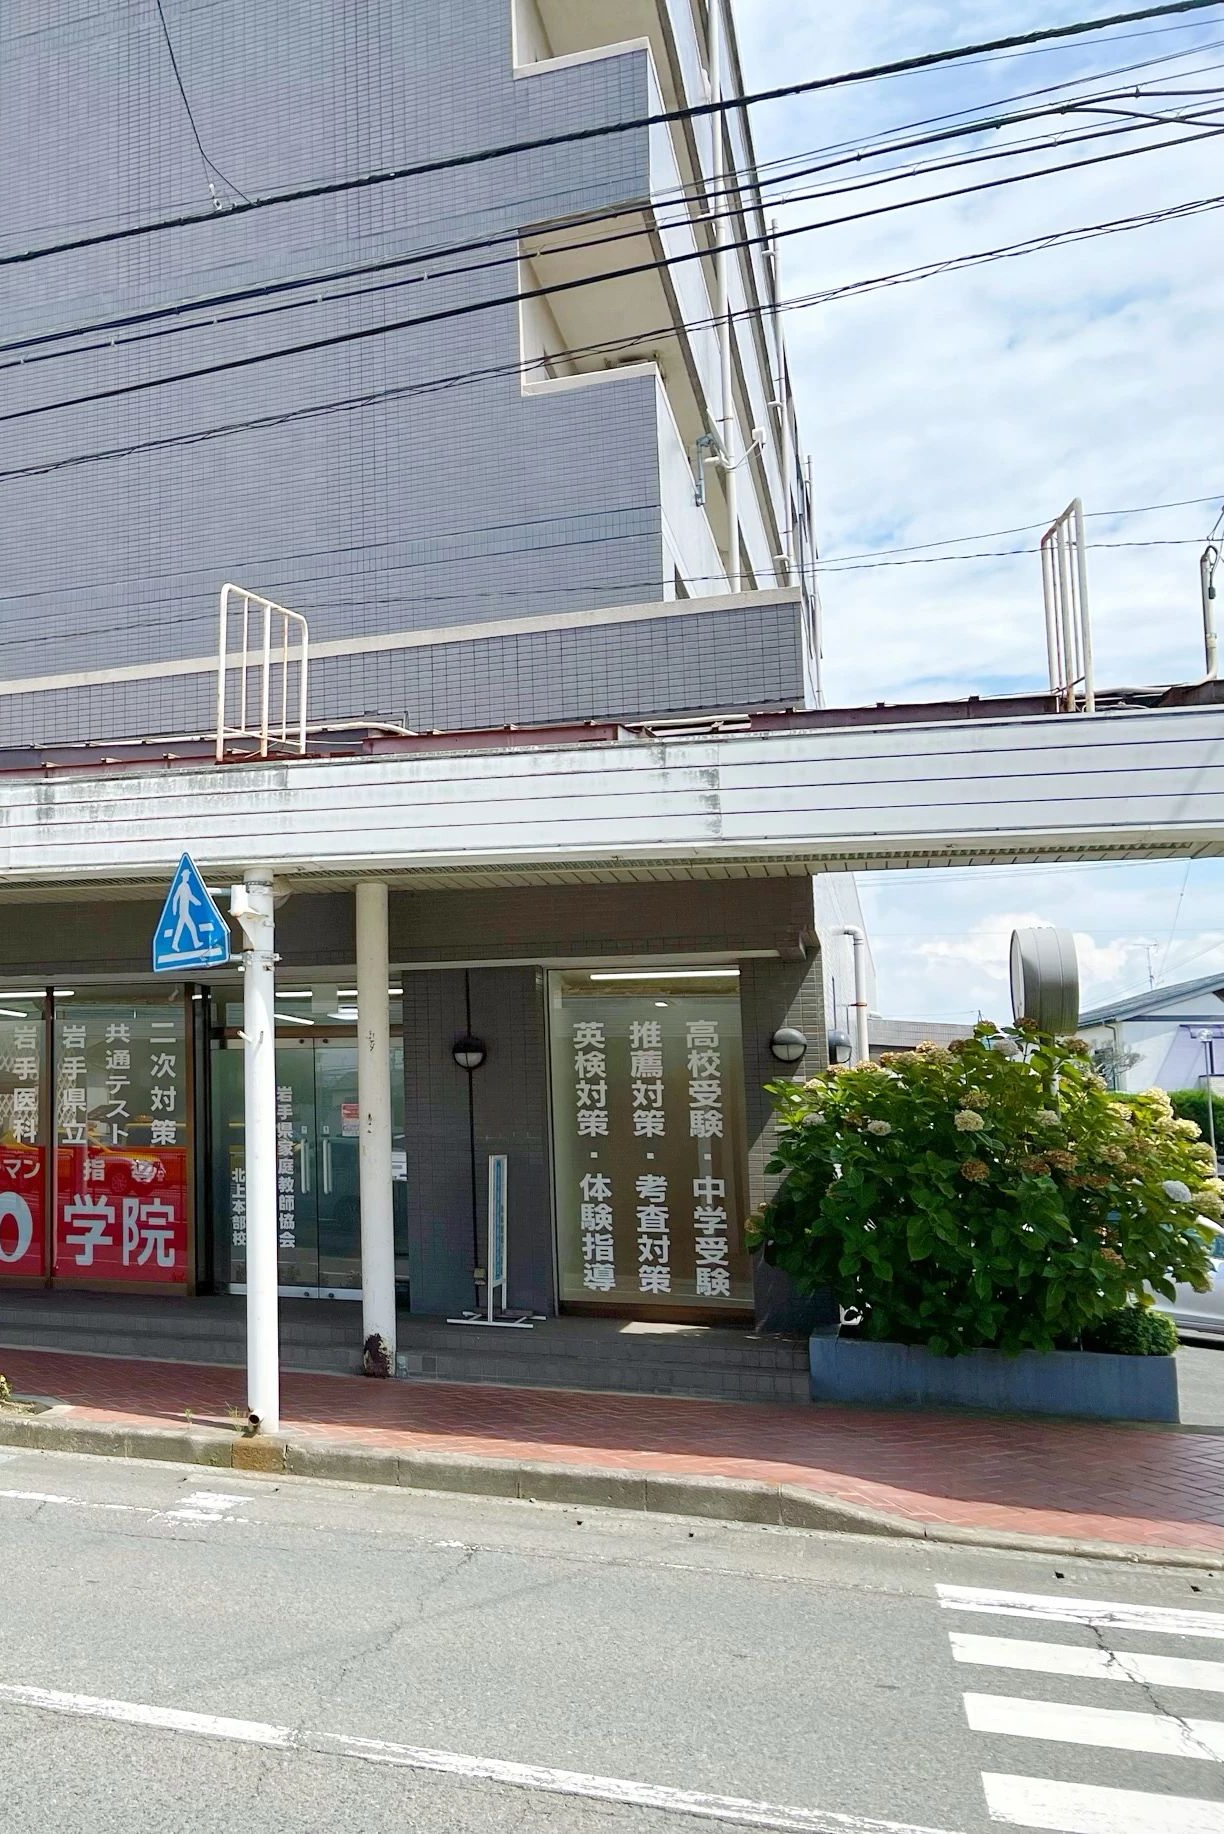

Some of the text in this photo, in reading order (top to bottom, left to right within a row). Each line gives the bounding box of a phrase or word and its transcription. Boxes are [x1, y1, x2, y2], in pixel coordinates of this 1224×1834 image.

[13, 1025, 38, 1144] 岩手医科
[62, 1025, 87, 1145] 岩手県立
[105, 1024, 130, 1145] 共通テスト
[150, 1022, 177, 1145] 二次対策
[231, 1167, 247, 1246] 北上本部校
[276, 1086, 296, 1248] 岩手県家庭教師協会
[64, 1193, 175, 1267] 学院
